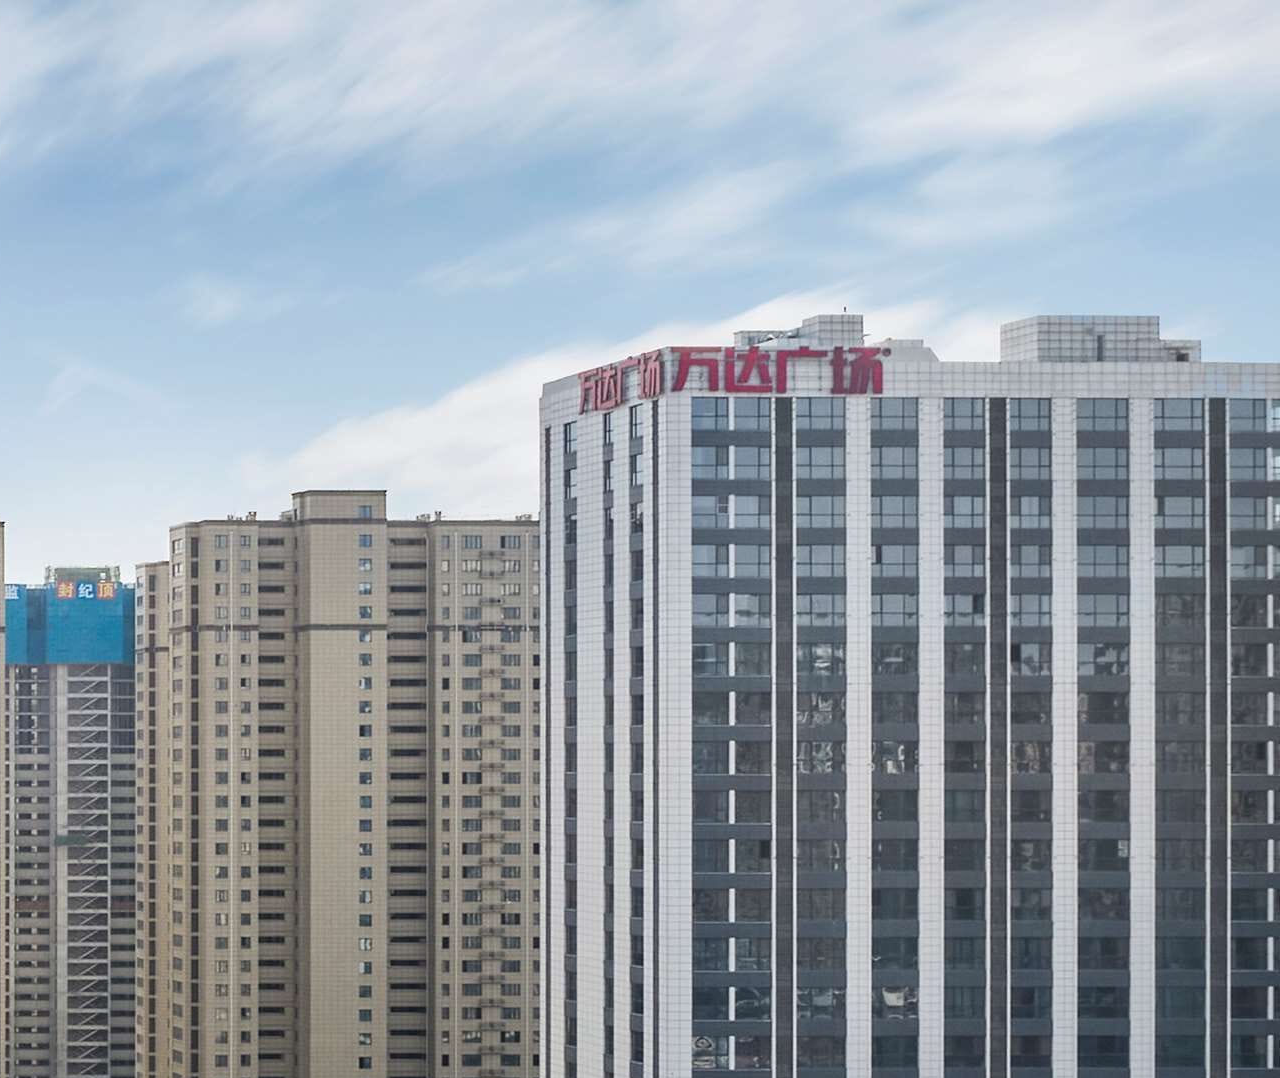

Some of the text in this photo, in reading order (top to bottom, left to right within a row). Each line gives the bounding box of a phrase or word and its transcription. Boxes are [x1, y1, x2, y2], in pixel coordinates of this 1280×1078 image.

[577, 350, 661, 415] 万达广场
[670, 346, 884, 394] 万达广场
